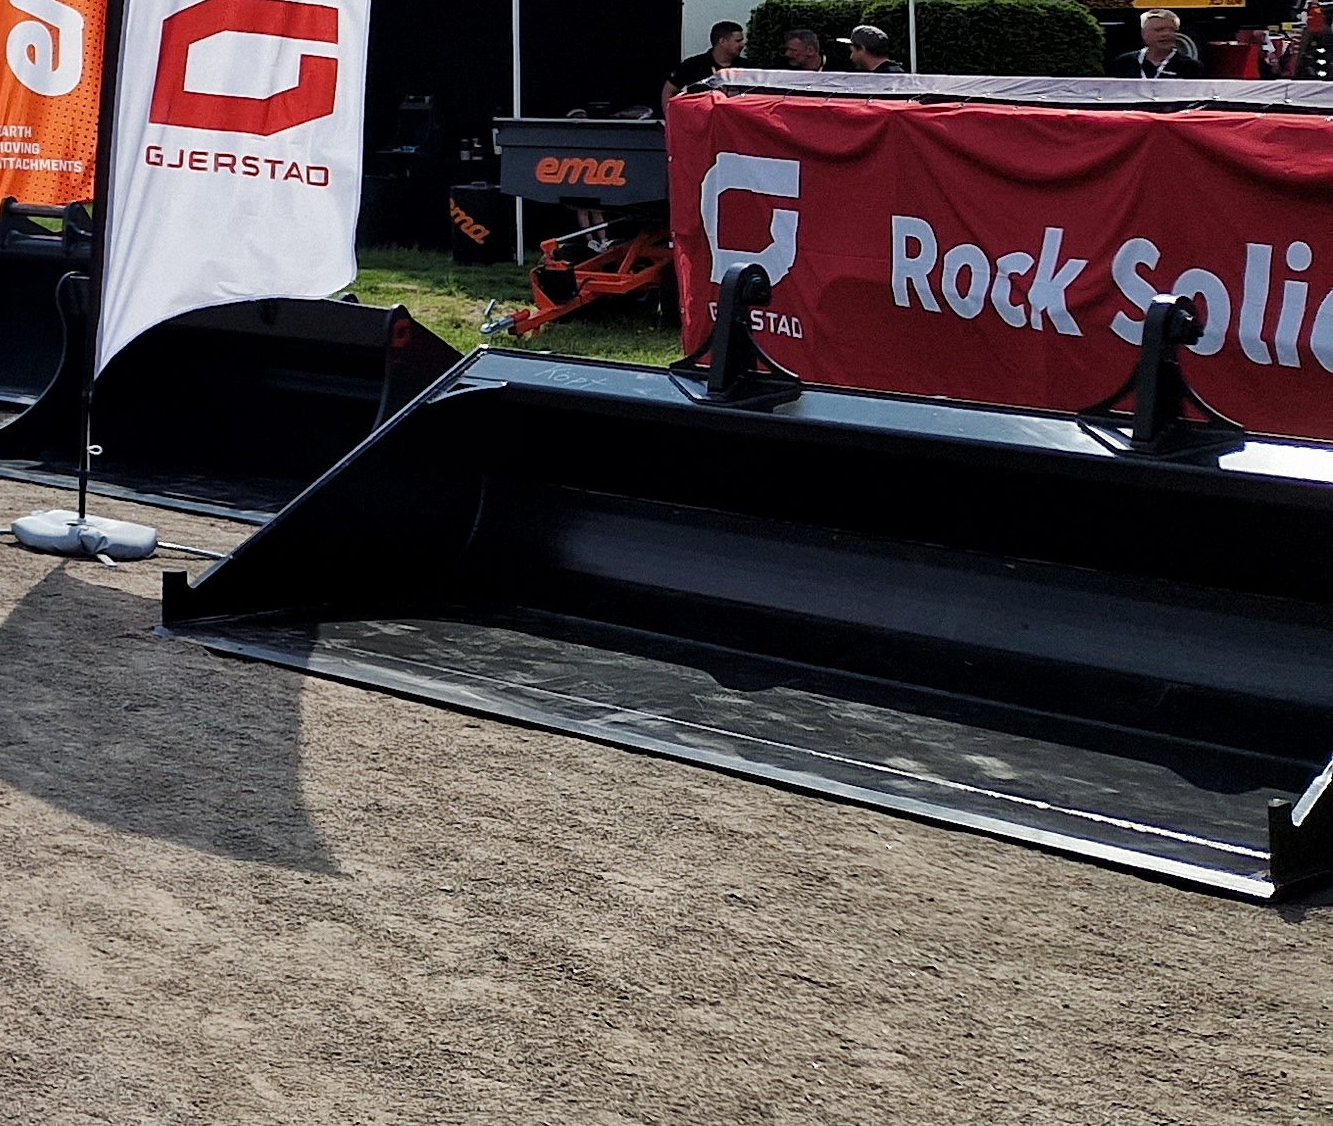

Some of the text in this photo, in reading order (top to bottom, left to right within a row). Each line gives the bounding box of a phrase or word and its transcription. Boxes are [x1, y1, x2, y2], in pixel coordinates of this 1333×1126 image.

[144, 144, 330, 187] GJERSTAD
[535, 156, 627, 187] ema
[449, 197, 492, 245] ma
[890, 214, 1090, 338] Rock
[708, 300, 804, 340] GSTAD
